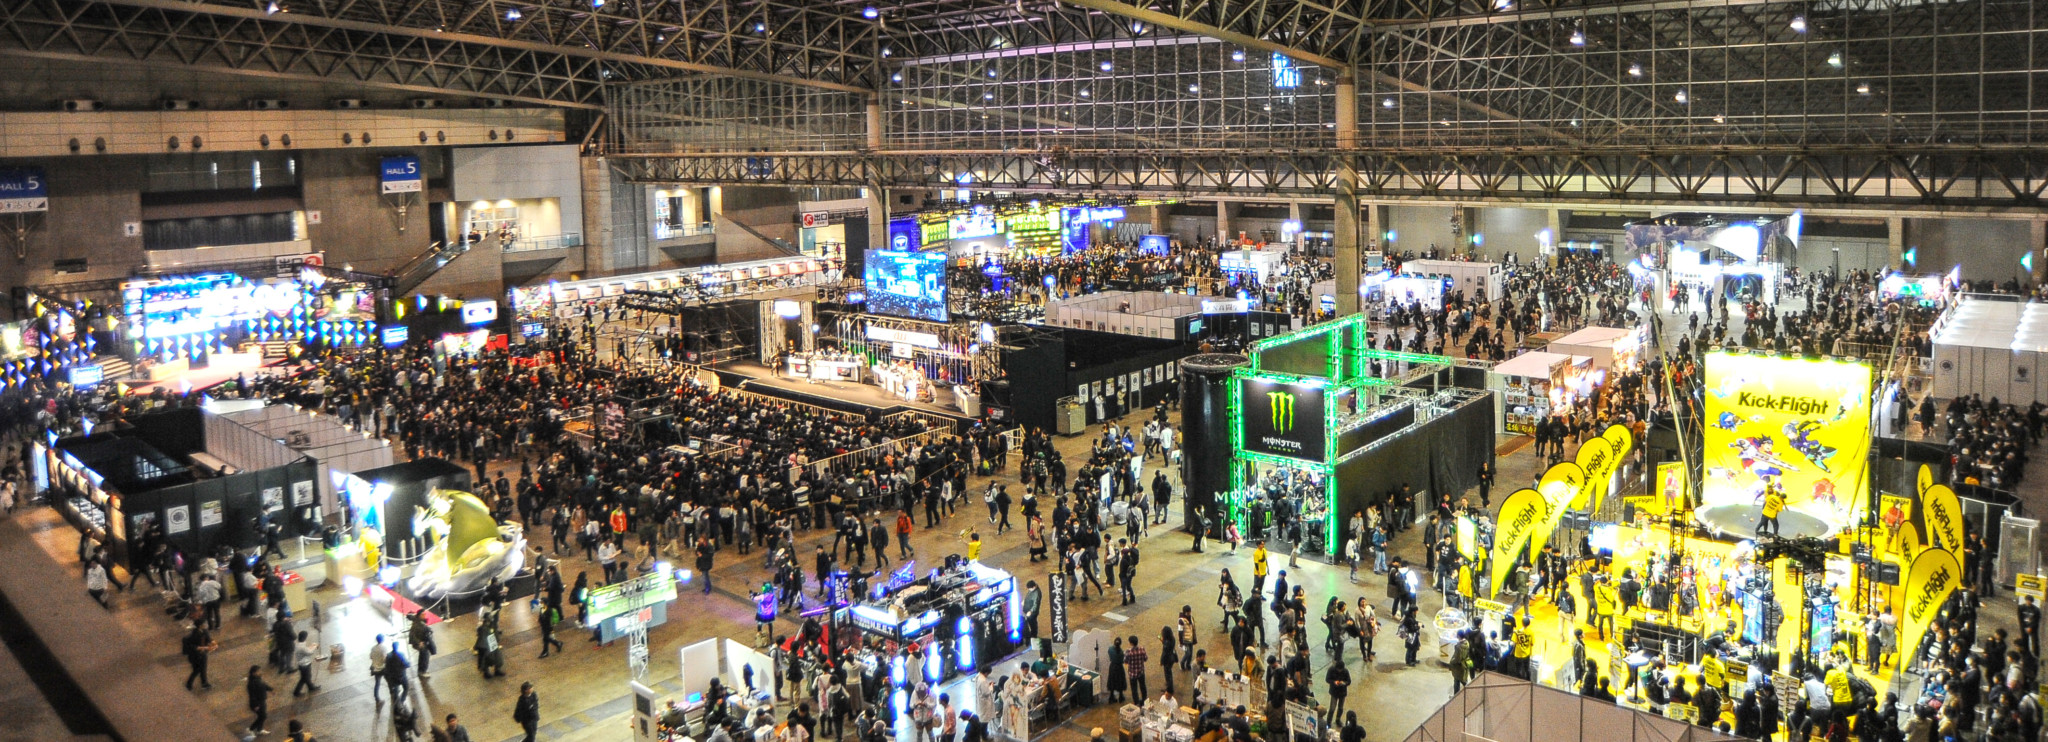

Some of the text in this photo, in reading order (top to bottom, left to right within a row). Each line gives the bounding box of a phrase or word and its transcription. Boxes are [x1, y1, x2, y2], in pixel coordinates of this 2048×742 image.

[407, 162, 416, 174] 5
[28, 175, 40, 190] 5
[1262, 436, 1302, 450] MONSTER
